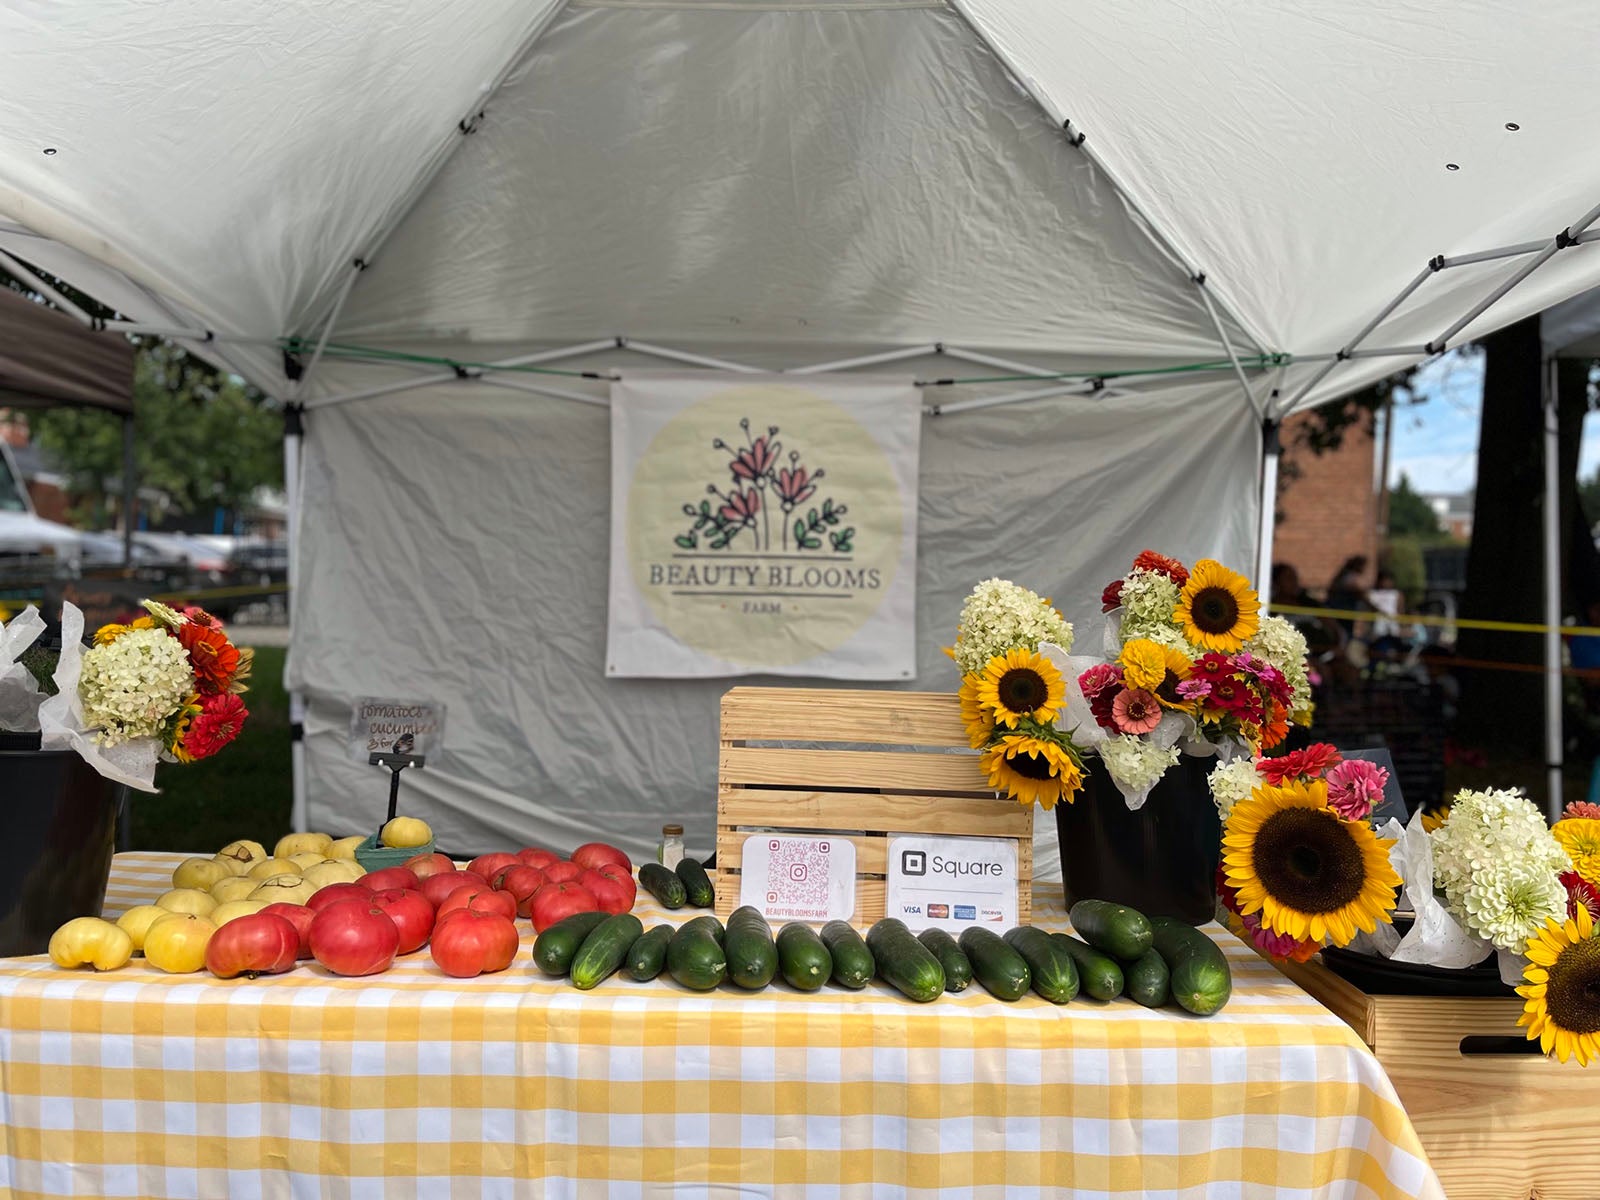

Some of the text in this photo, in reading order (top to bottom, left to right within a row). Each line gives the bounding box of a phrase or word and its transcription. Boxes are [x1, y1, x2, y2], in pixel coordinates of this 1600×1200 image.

[650, 564, 881, 589] BEAUTY BLOOMS
[742, 602, 782, 614] FARM
[932, 856, 1003, 878] Square
[765, 907, 829, 918] BEAUTYBLOOMSFARM
[903, 906, 921, 914] VISA
